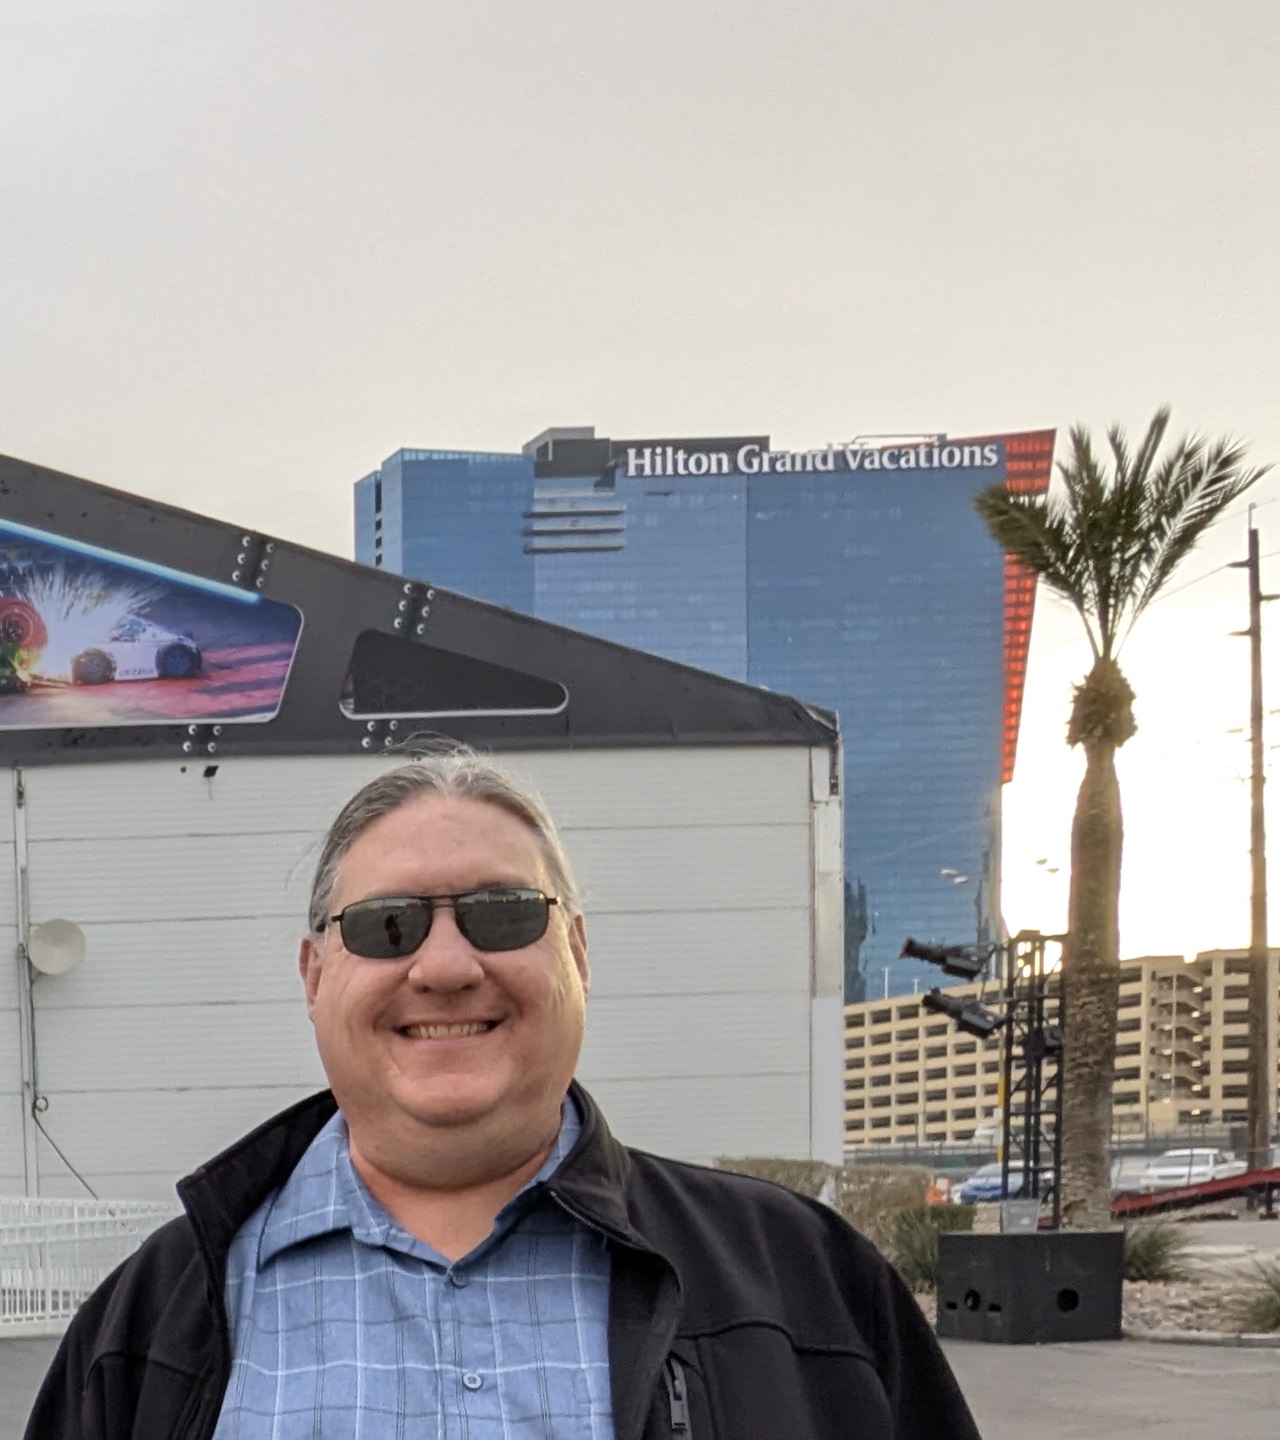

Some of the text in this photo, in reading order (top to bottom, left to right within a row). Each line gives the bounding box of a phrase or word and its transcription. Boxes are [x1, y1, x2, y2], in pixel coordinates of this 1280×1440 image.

[626, 441, 999, 477] Hilton Grand Vacations
